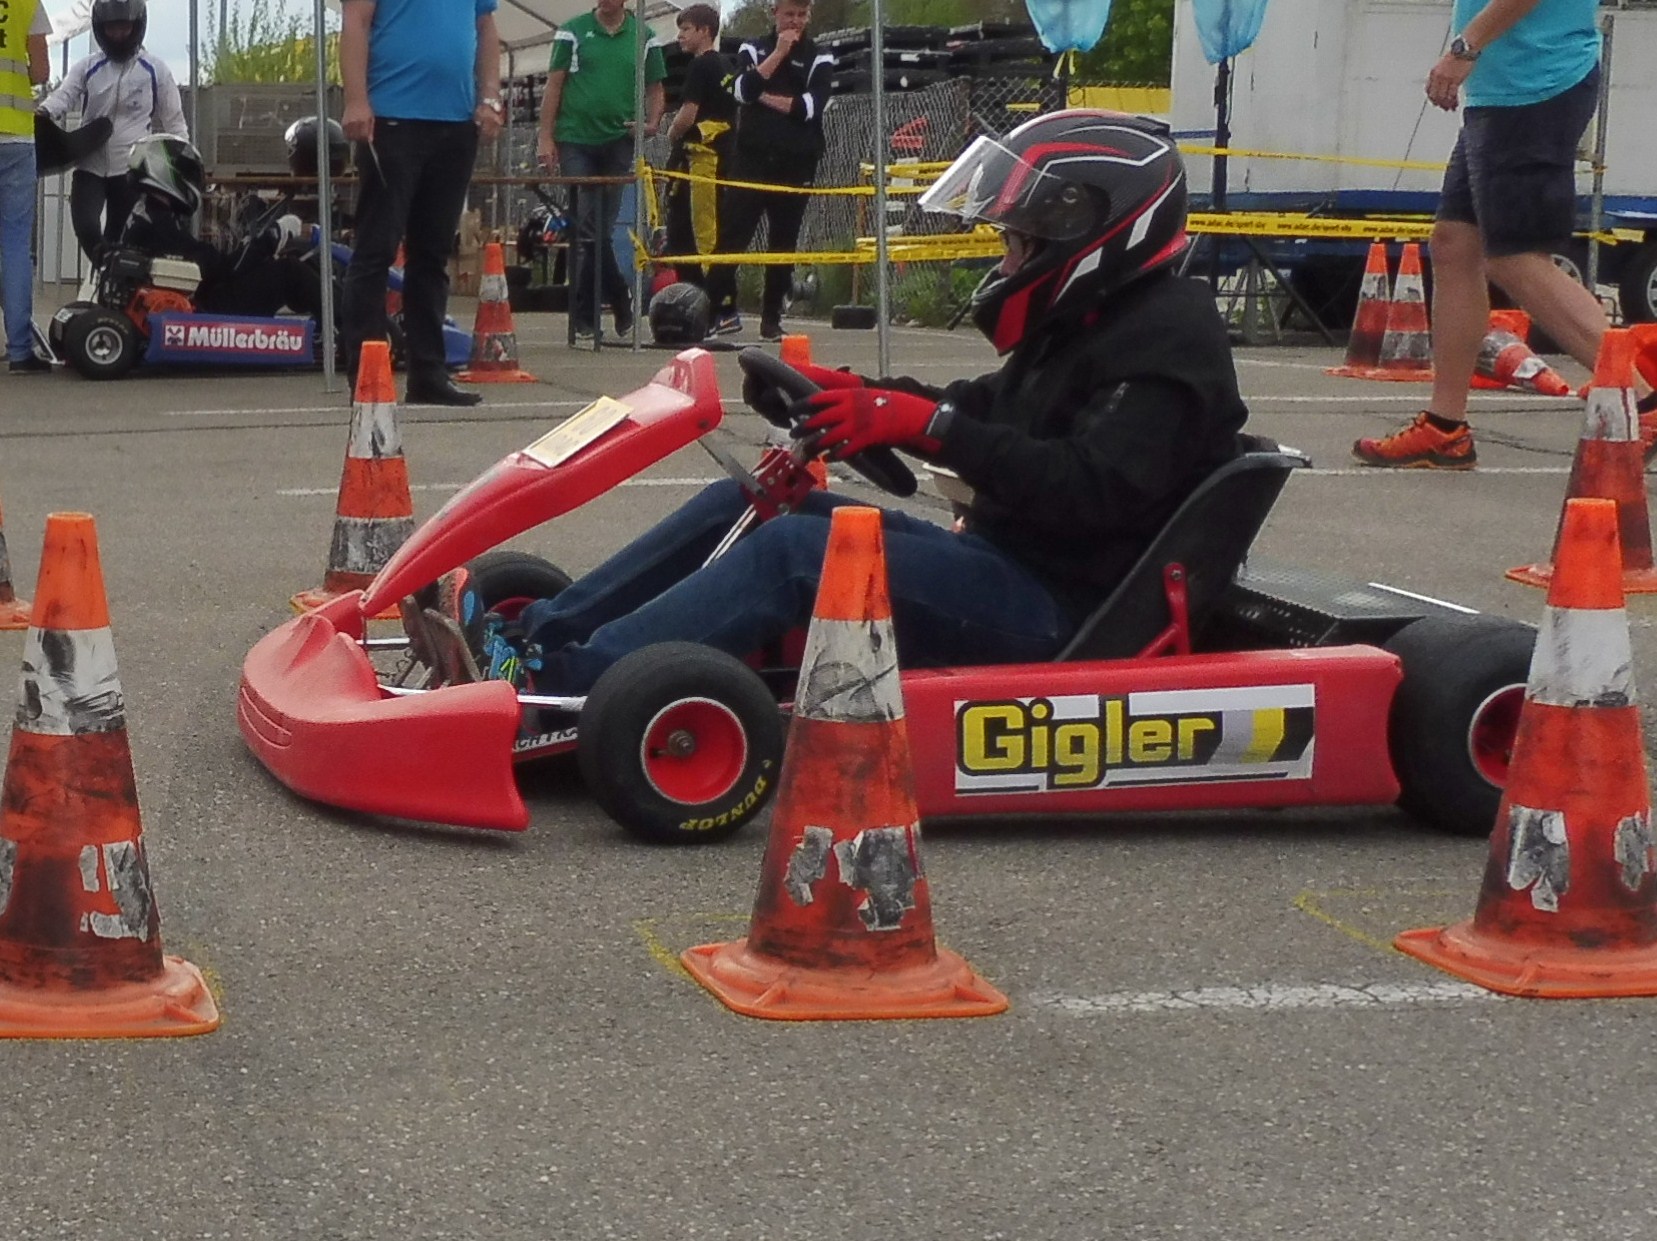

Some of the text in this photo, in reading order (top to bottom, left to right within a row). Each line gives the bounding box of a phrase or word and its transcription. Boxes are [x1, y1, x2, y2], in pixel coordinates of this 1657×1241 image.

[187, 326, 302, 350] Müllerbräu
[961, 698, 1216, 787] Gigler
[679, 775, 767, 830] DUNLOP
